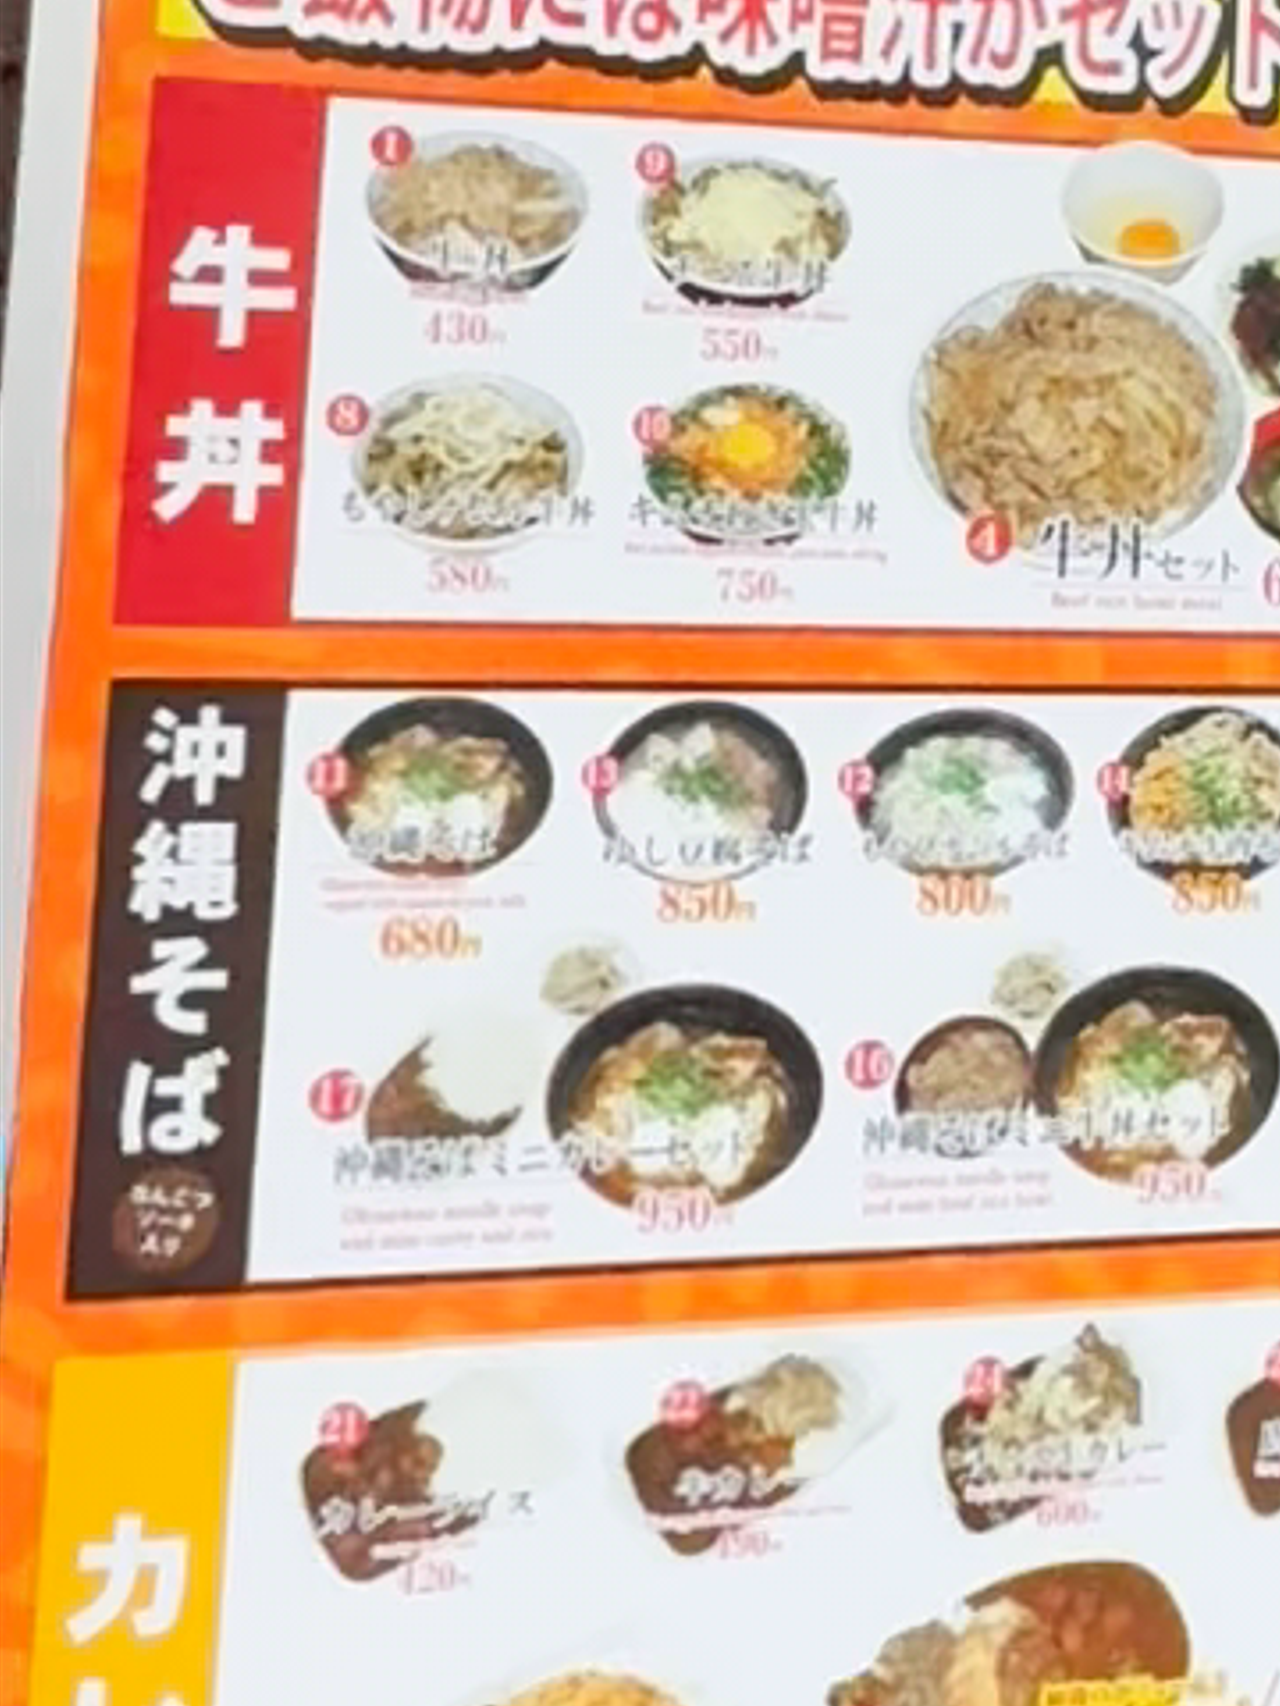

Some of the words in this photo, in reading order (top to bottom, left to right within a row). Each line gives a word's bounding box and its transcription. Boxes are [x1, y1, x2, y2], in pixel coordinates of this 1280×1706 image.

[150, 224, 297, 524] 牛丼
[1036, 517, 1243, 583] 牛丼セット
[119, 703, 249, 1159] 沖縄そば
